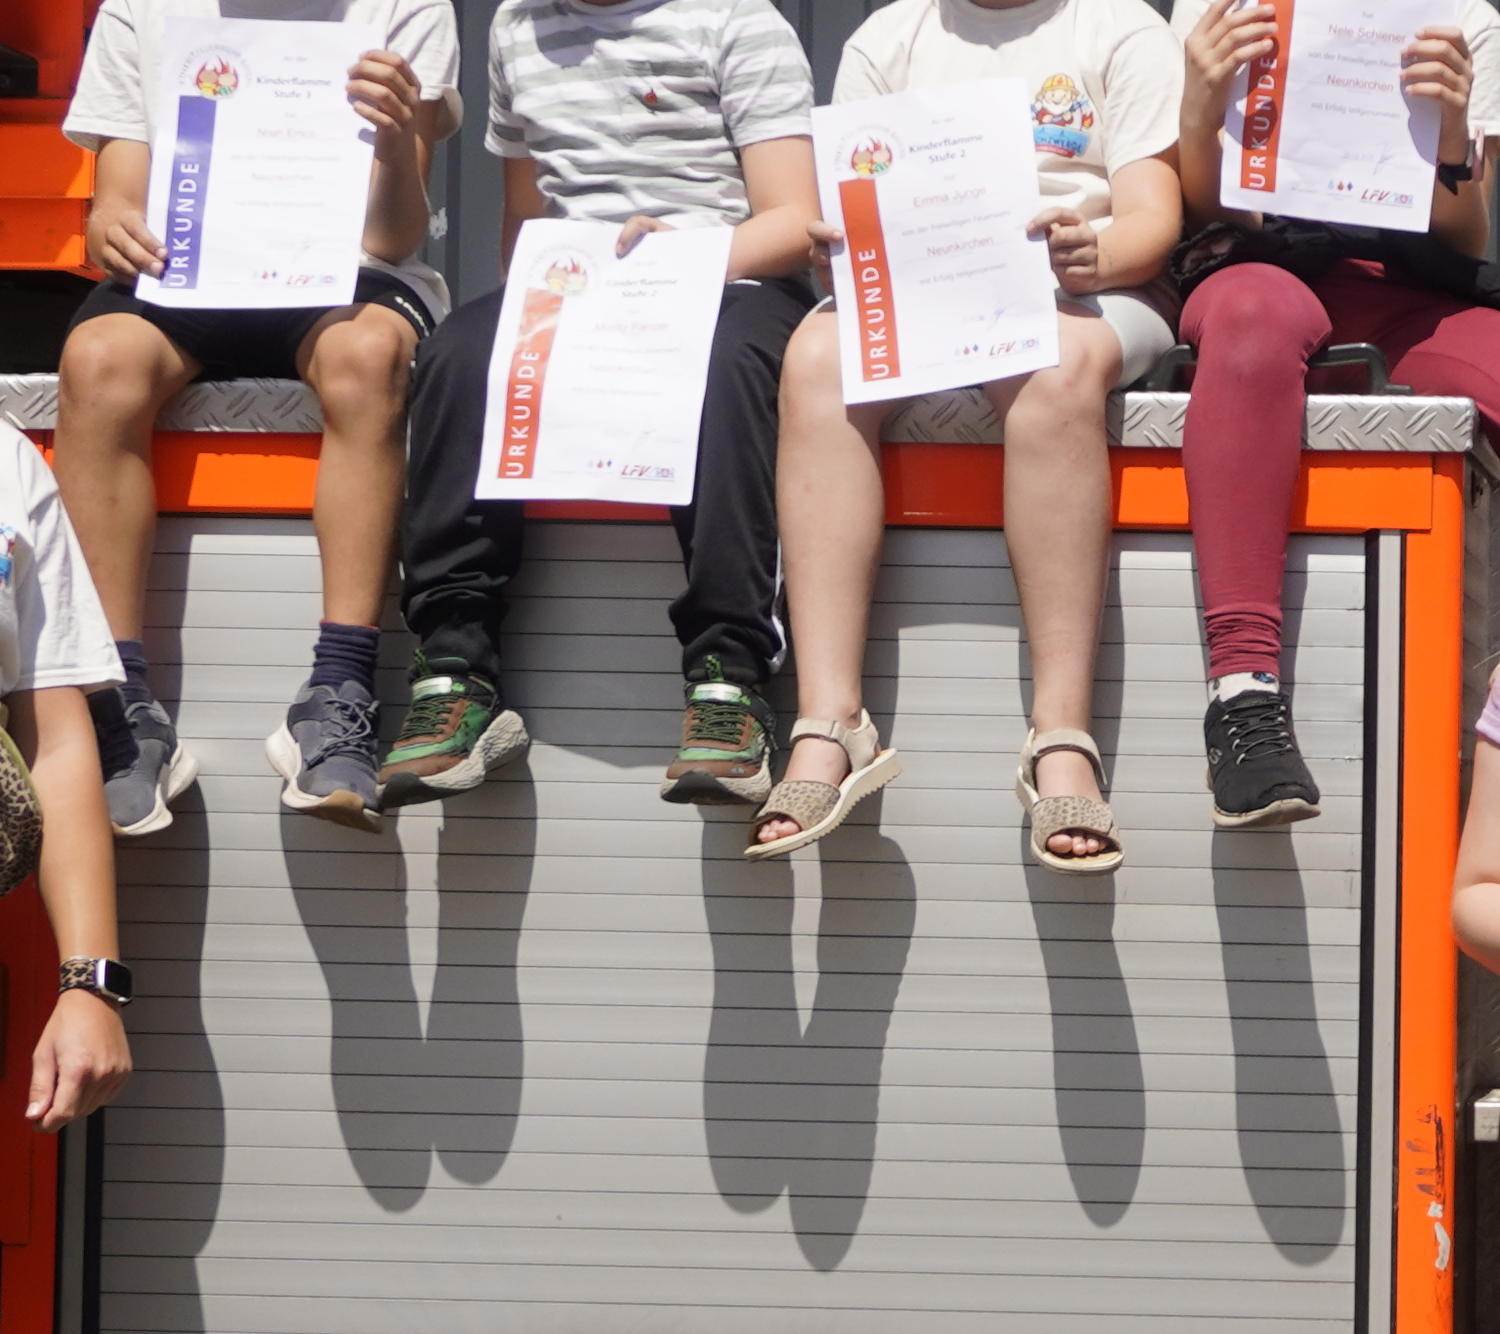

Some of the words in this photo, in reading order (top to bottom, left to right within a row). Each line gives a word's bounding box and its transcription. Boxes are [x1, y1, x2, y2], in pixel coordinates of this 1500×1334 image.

[1328, 24, 1354, 37] Nele
[256, 76, 332, 87] Kinderflamme
[1327, 74, 1394, 92] Neunkirchen
[1249, 58, 1277, 188] URKUNDE
[908, 133, 983, 154] Kinderflamme
[928, 153, 956, 164] Stufe
[960, 149, 967, 158] 2
[913, 194, 949, 208] Emma
[1361, 188, 1391, 202] LFV
[168, 162, 199, 288] URKUNDE
[926, 236, 994, 257] Neunkirchen
[858, 248, 890, 380] URKUNDE
[506, 351, 540, 477] URKUNDE
